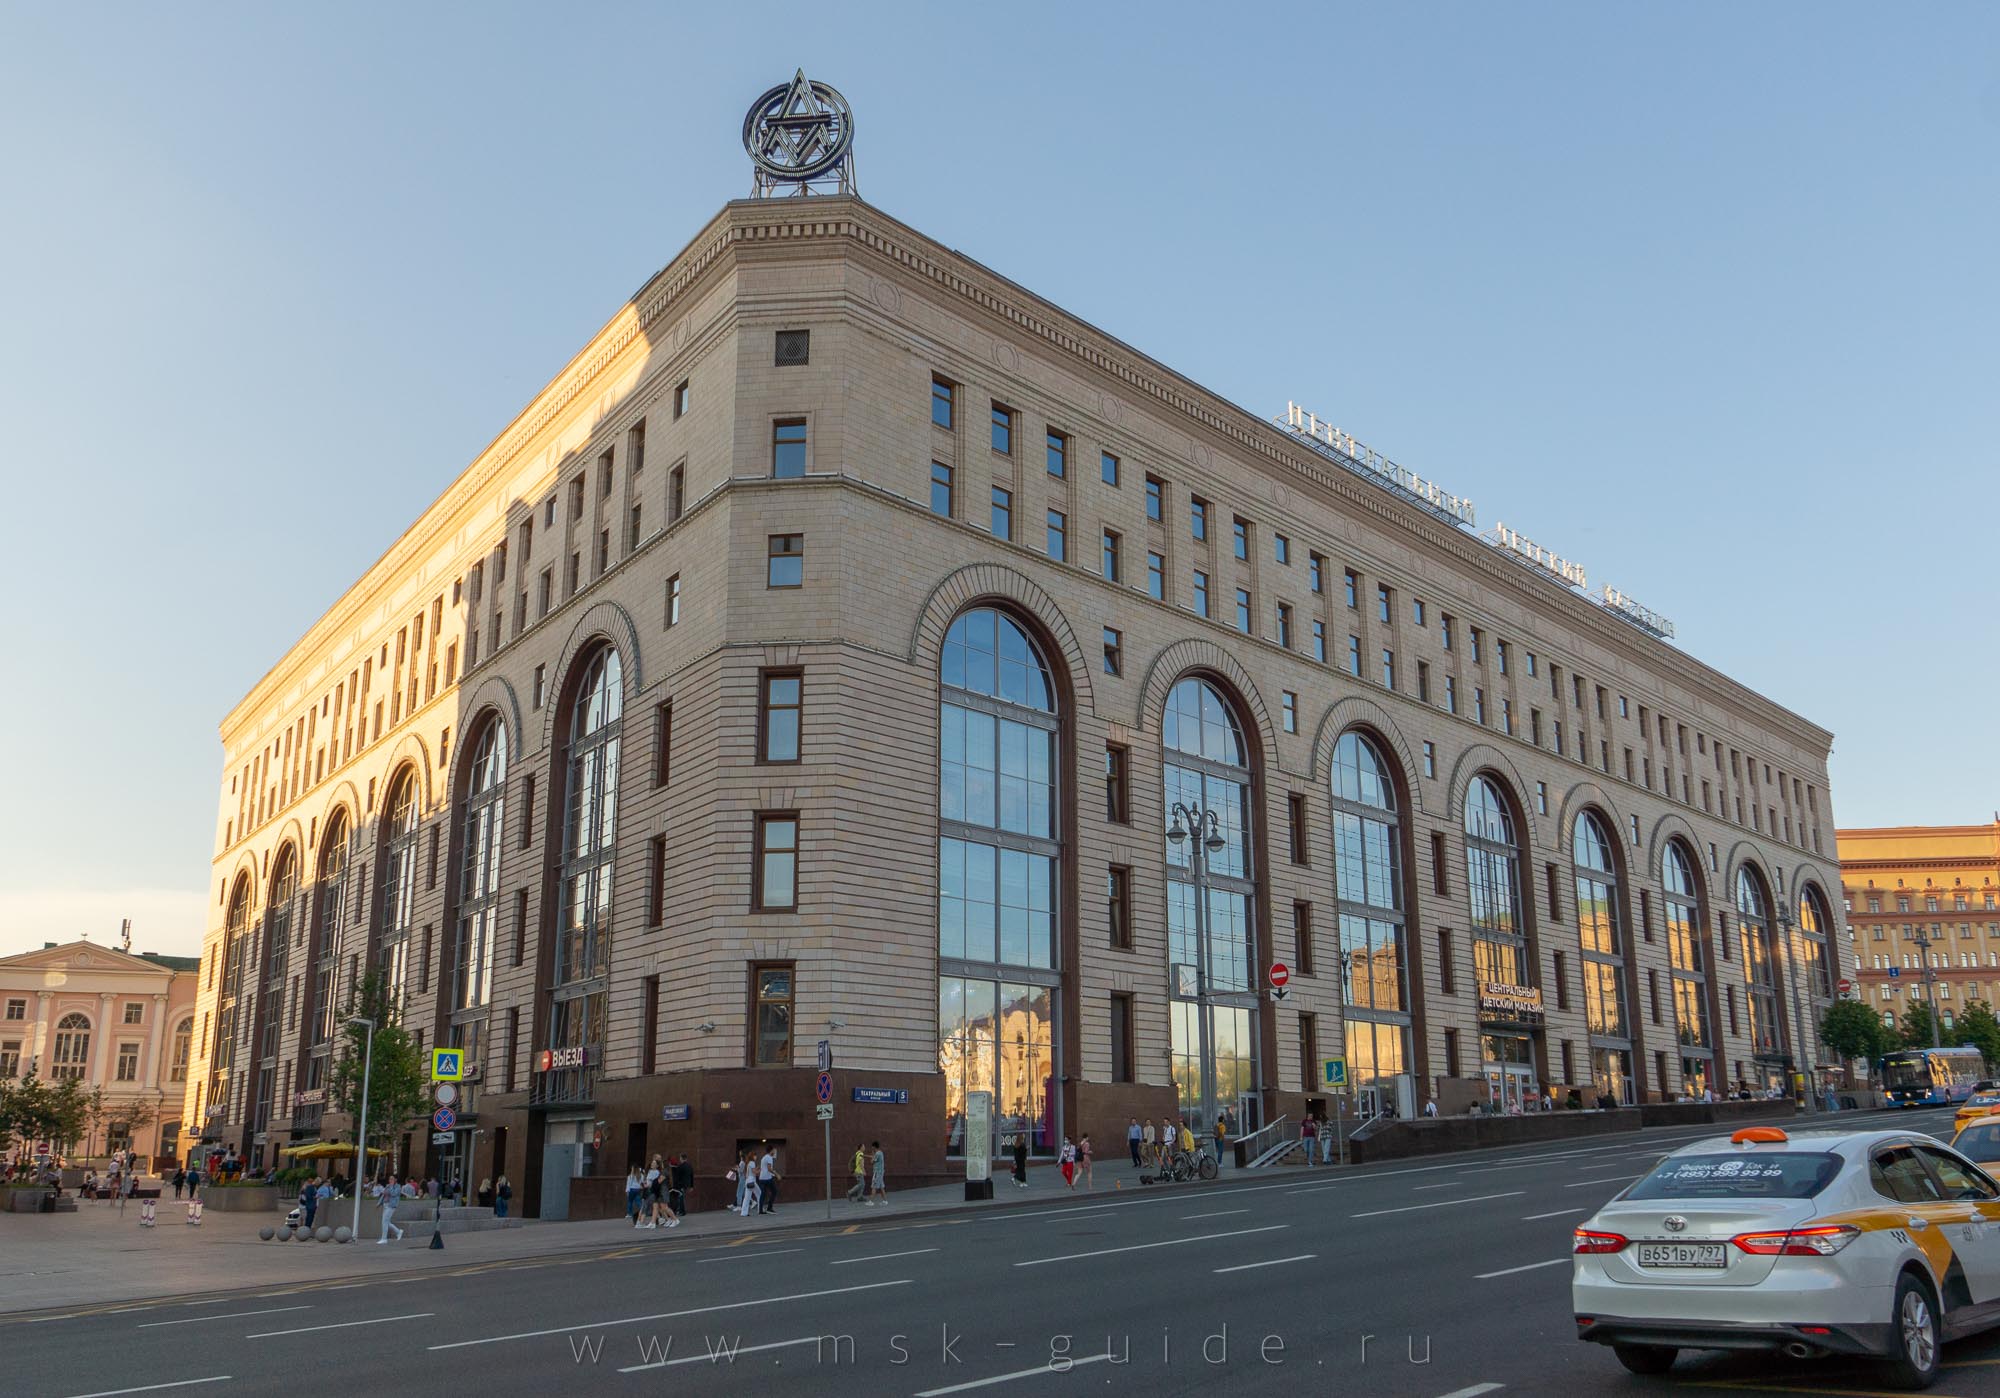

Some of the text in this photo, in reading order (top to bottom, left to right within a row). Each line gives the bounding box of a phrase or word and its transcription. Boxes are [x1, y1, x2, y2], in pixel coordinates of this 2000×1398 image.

[1488, 982, 1536, 998] ЦЕНТРАЛЬНЫЙ
[1483, 996, 1544, 1013] ДЕТСКИЙ МАГАЗИН
[552, 1046, 584, 1067] ВЫЕЗД
[1674, 1170, 1709, 1179] (495)
[1711, 1169, 1739, 1177] 999
[1740, 1169, 1759, 1177] 99
[1761, 1169, 1782, 1177] 99
[1699, 1246, 1720, 1258] 797
